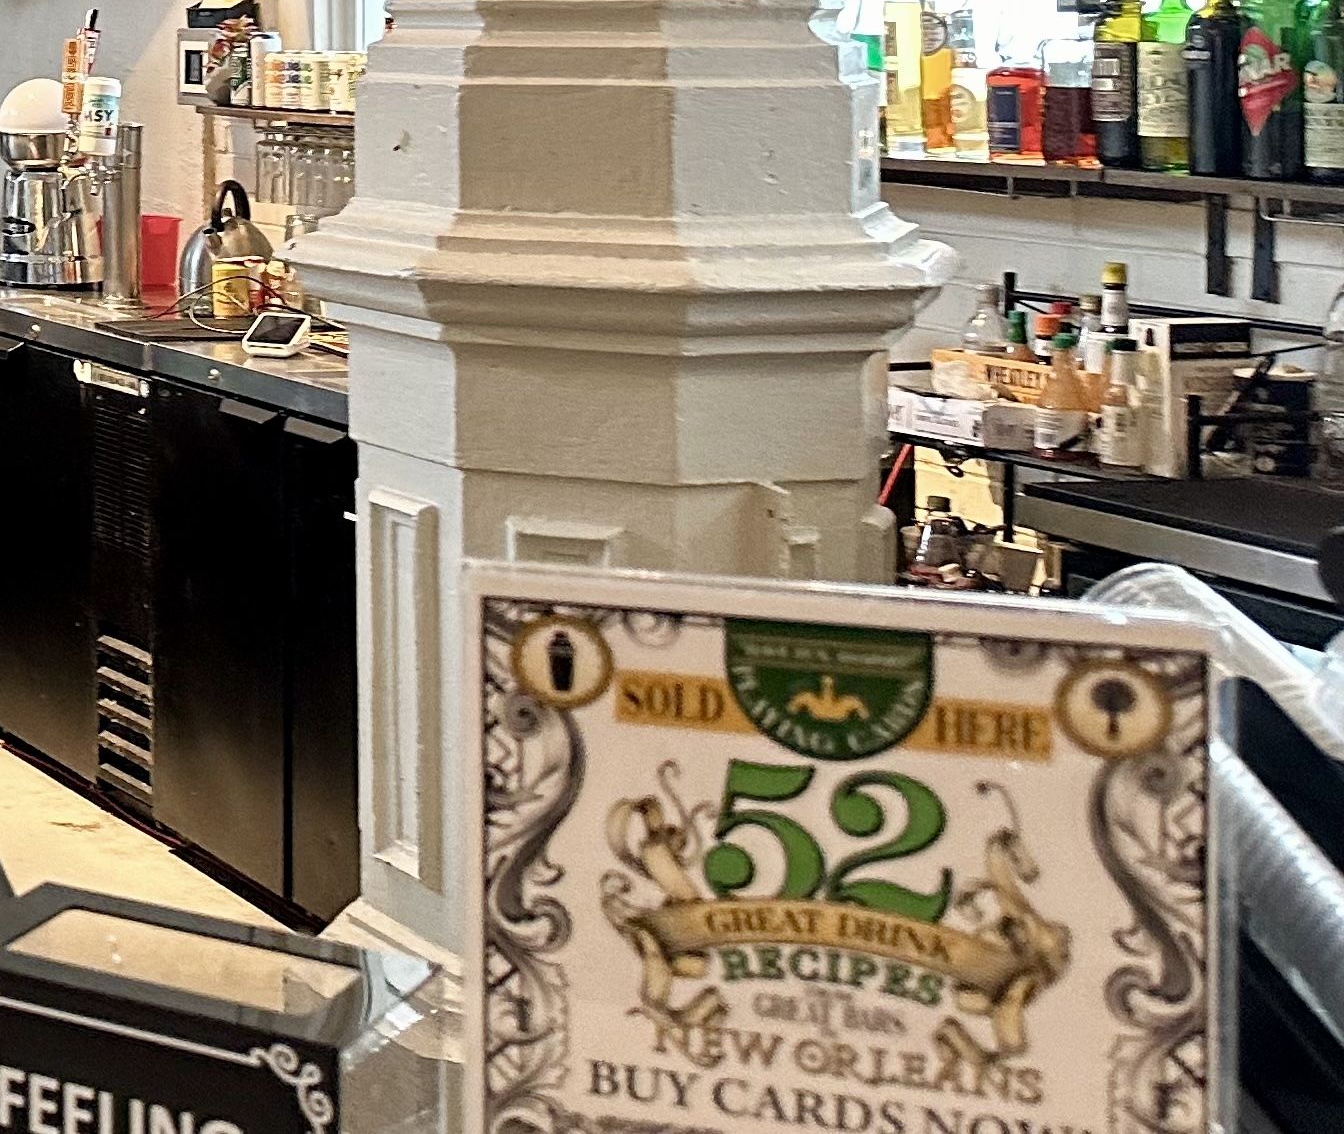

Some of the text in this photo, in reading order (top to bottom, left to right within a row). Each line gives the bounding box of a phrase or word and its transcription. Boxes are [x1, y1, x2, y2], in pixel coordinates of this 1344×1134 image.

[620, 678, 1040, 752] SOLD HERE
[703, 758, 954, 924] 52
[705, 905, 952, 964] GREAT DRINK
[717, 946, 945, 1006] RECIPES
[587, 1059, 701, 1108] BUY
[711, 1076, 906, 1131] CARDS
[653, 1022, 1045, 1105] NEW ORLEANS
